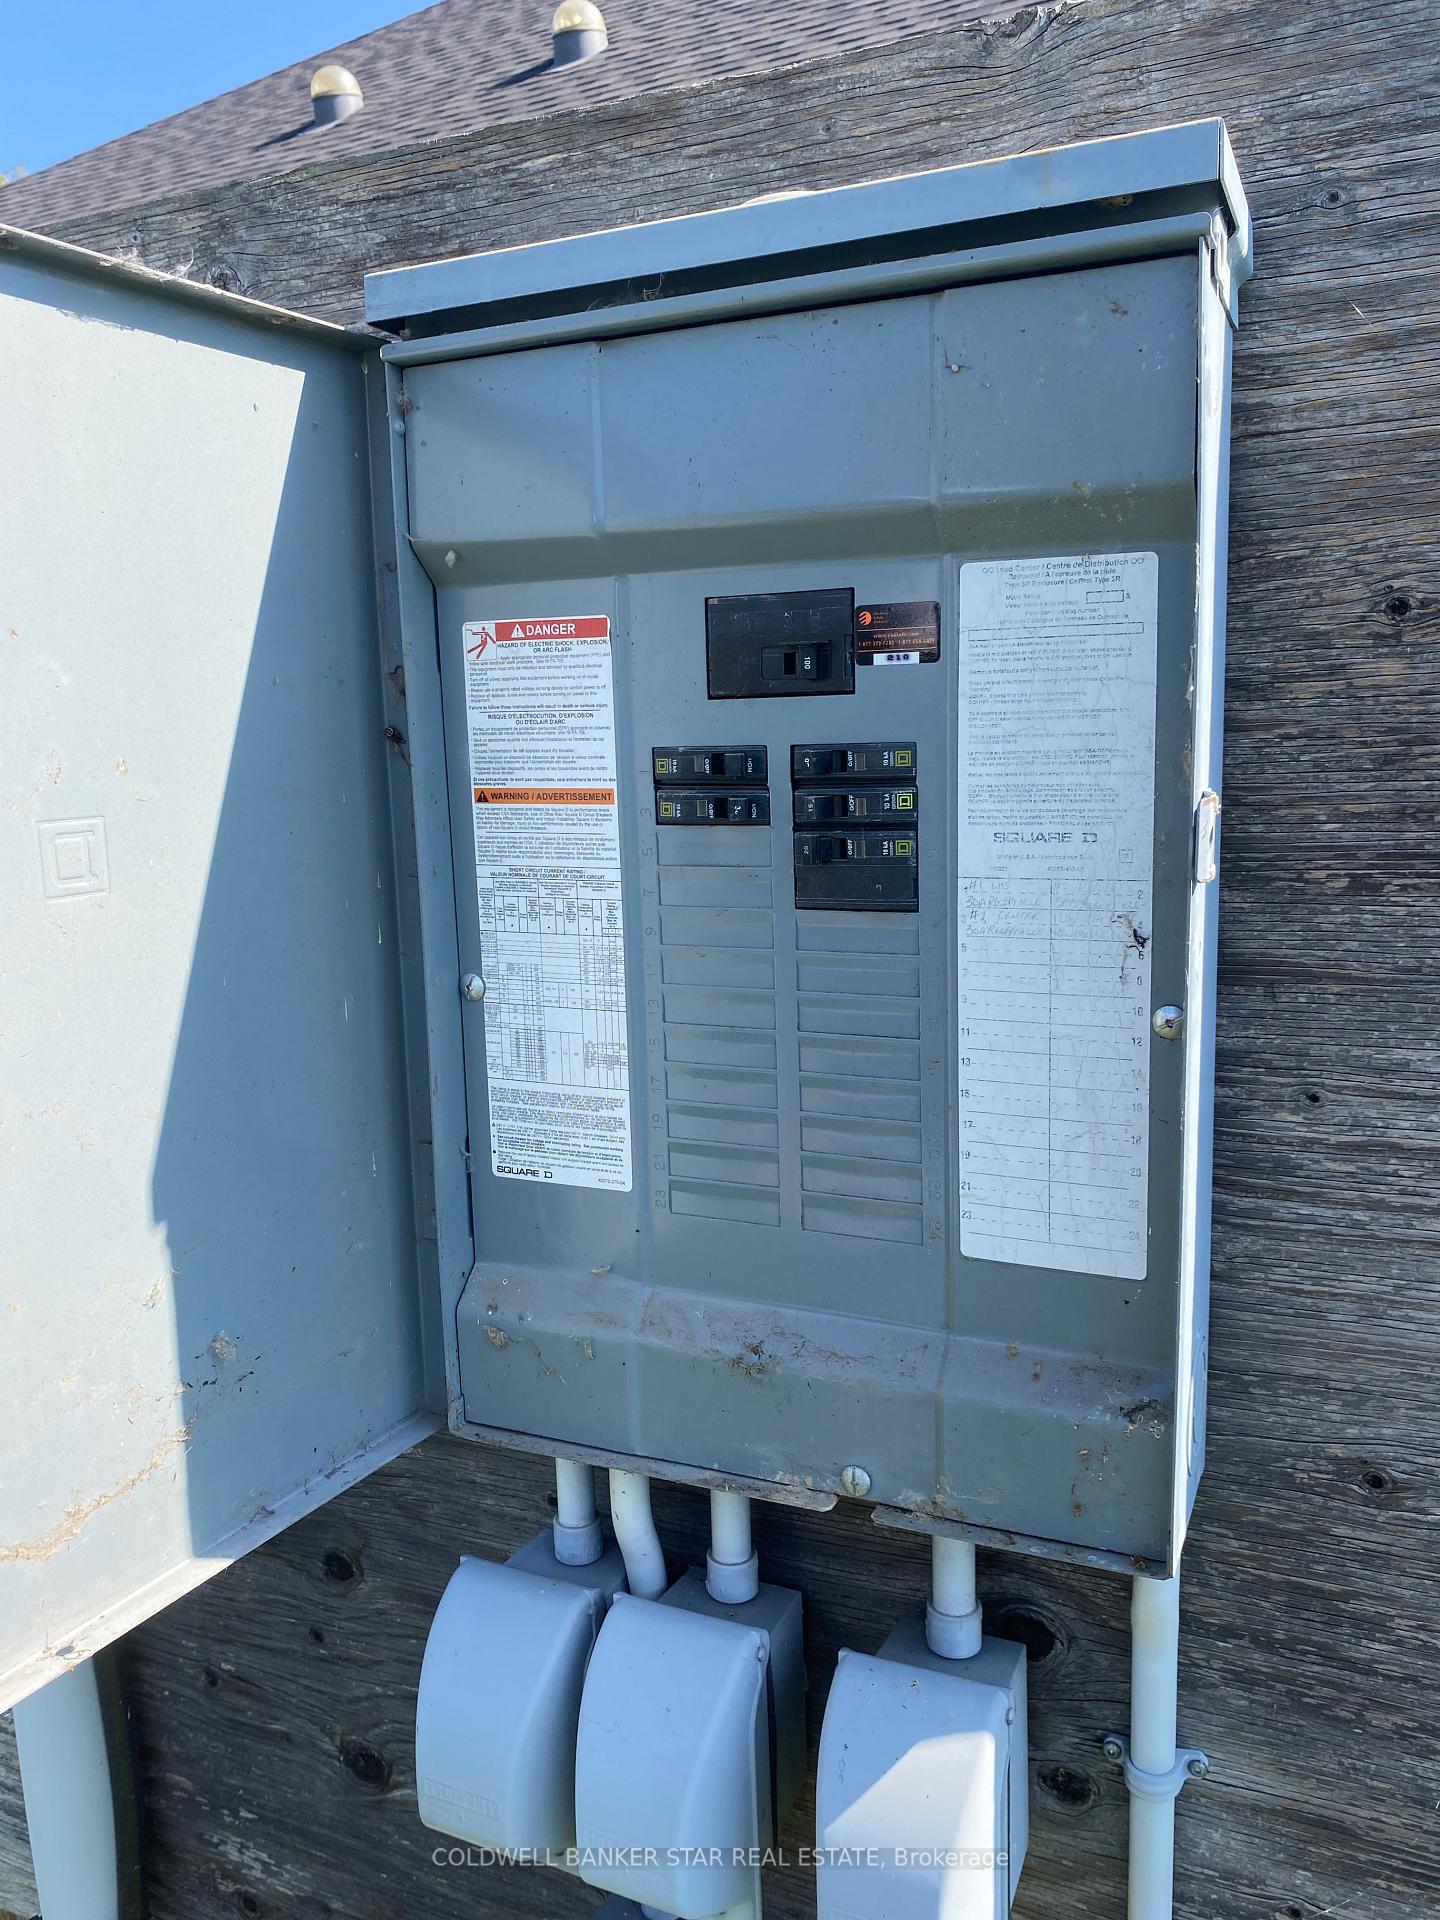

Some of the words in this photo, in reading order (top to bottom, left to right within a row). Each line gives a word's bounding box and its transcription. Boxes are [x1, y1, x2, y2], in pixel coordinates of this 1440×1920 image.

[1046, 562, 1070, 570] Centre
[1084, 560, 1129, 568] Distribution
[1094, 576, 1110, 585] Type
[526, 623, 576, 636] DANGER
[528, 640, 554, 648] ELECTRIC
[886, 653, 910, 661] 210
[490, 792, 530, 800] WARNING
[536, 792, 612, 801] ADVERTISSEMENT
[884, 802, 890, 810] 10
[993, 832, 1074, 844] SQUARE
[1082, 832, 1098, 843] D
[1137, 890, 1144, 900] 2
[961, 943, 967, 951] 5
[960, 1028, 970, 1036] 11
[1132, 1037, 1143, 1046] 12
[960, 1058, 971, 1066] 13
[960, 1089, 970, 1098] 15
[961, 1152, 970, 1160] 19
[496, 1165, 540, 1177] SQUARE
[544, 1170, 553, 1178] D
[960, 1182, 971, 1190] 21
[960, 1210, 972, 1219] 23
